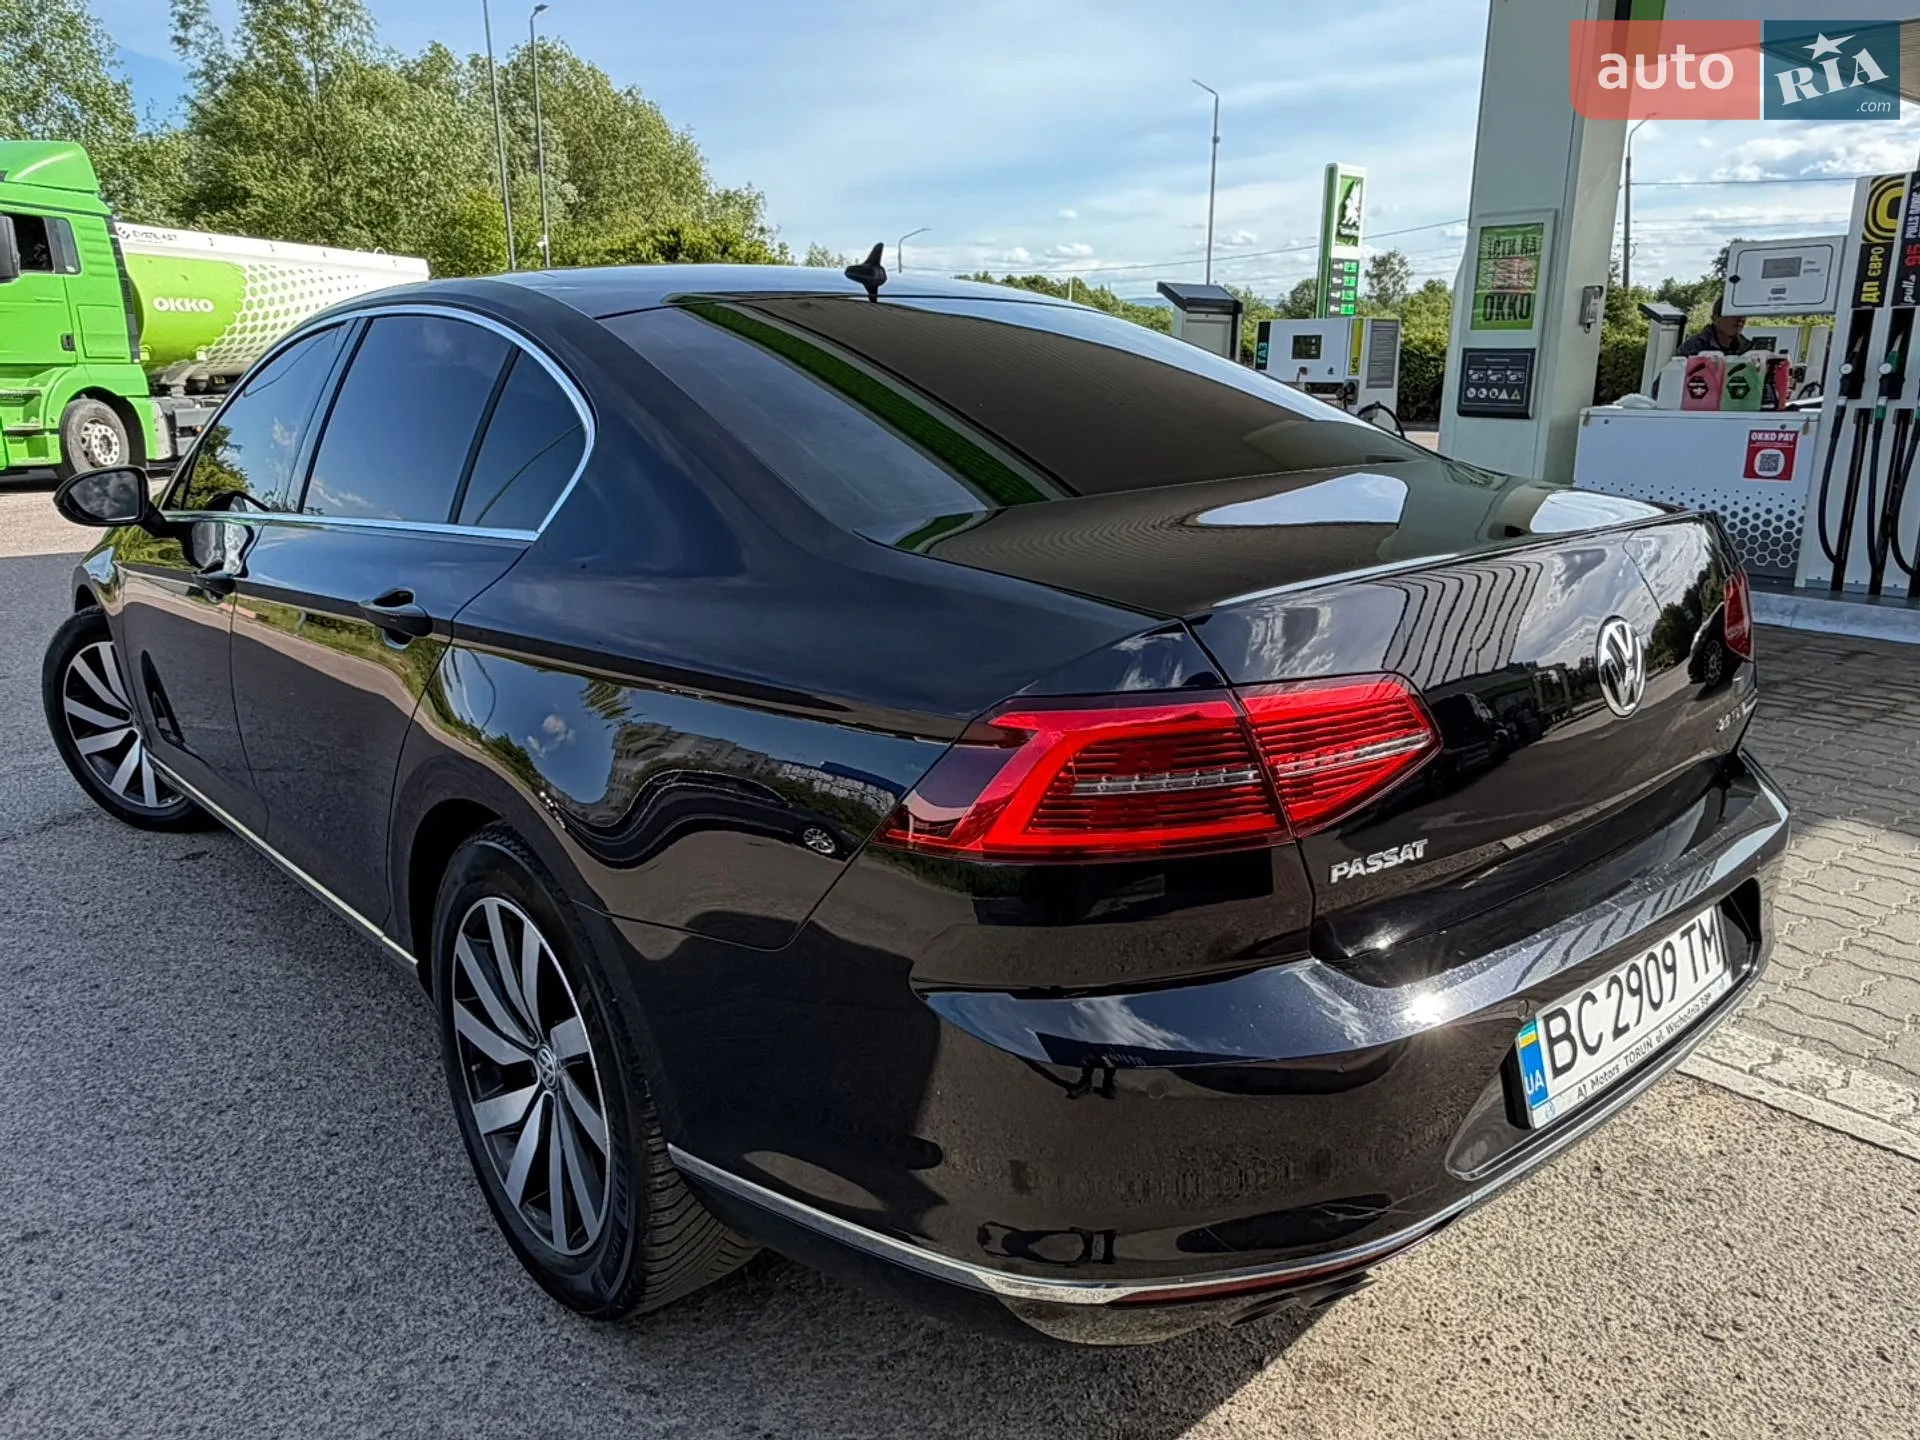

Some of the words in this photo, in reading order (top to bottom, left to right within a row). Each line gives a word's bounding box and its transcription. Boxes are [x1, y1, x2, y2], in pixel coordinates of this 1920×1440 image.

[1861, 280, 1880, 303] ДП
[153, 297, 214, 313] OKKO
[1256, 342, 1268, 363] ГАЗ
[1751, 432, 1777, 441] OKKO
[1778, 433, 1796, 441] PAY
[1330, 838, 1429, 884] PASSAT
[1542, 991, 1604, 1080] BC
[1605, 941, 1678, 1042] 2909
[1680, 910, 1720, 984] TM
[1525, 1072, 1546, 1095] UA
[1591, 1064, 1621, 1091] Motors
